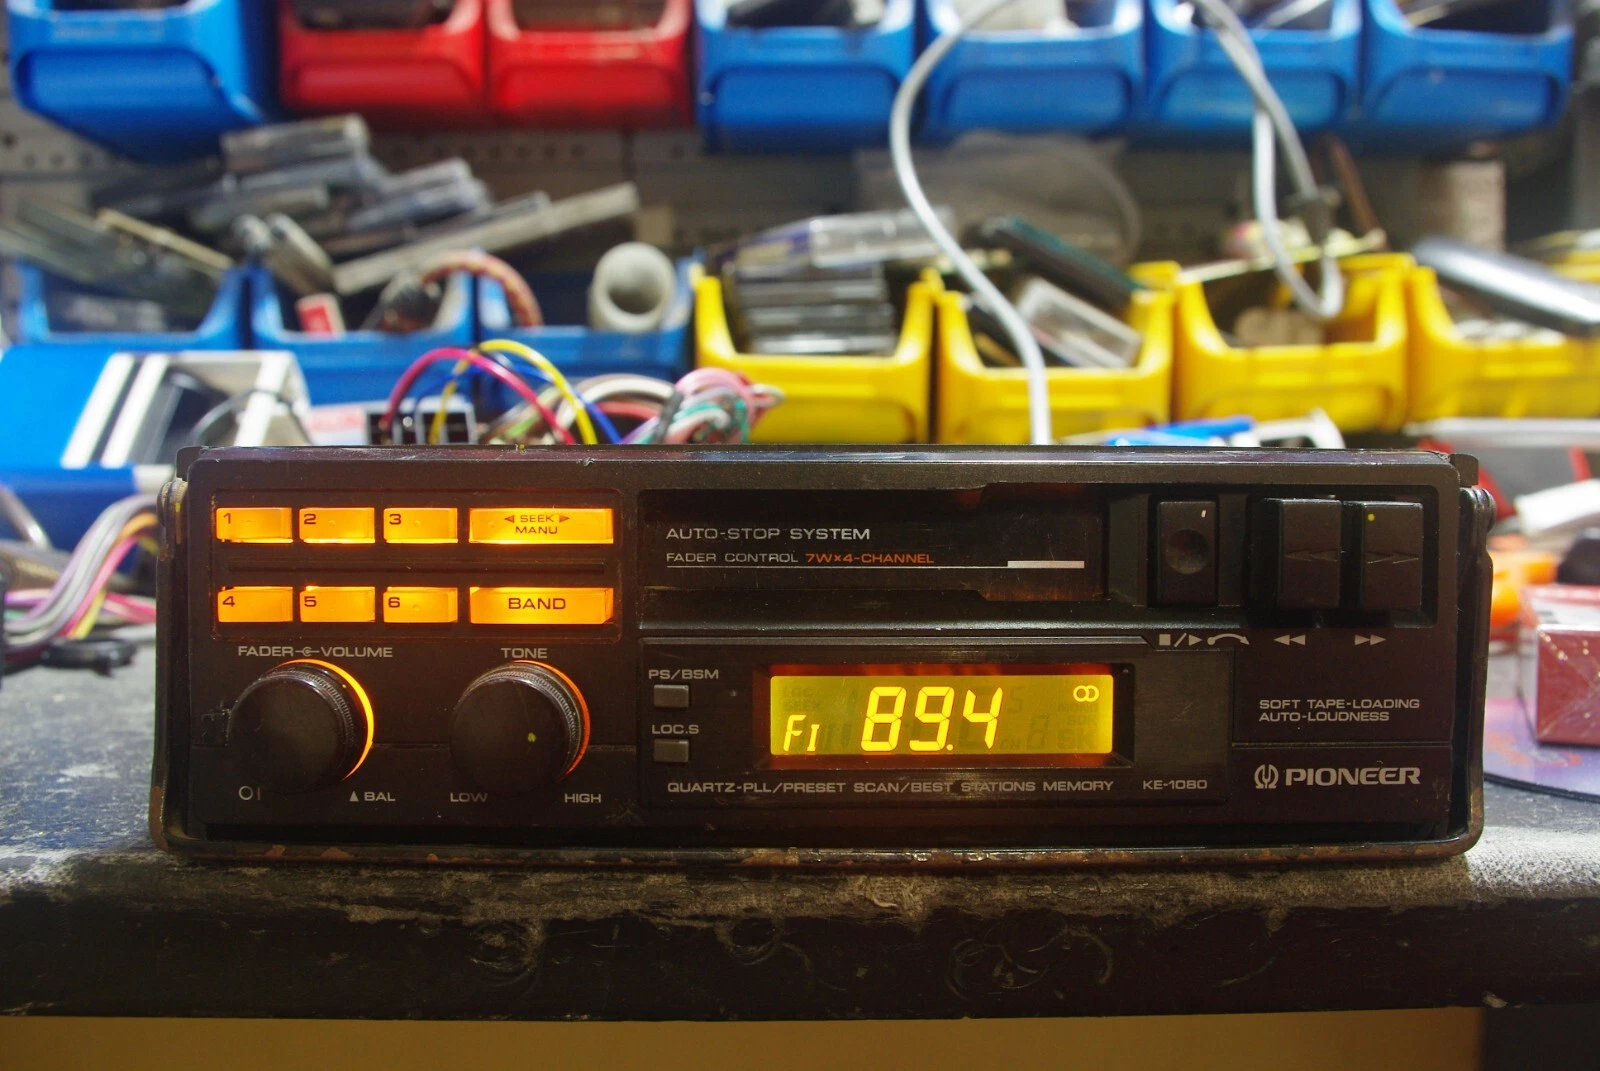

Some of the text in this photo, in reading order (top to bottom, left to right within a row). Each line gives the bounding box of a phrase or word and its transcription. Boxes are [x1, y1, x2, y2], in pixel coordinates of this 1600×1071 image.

[223, 512, 232, 524] 1
[303, 513, 317, 525] 2
[389, 513, 402, 525] 3
[520, 514, 554, 523] SEEK
[515, 525, 558, 535] MANU
[665, 527, 870, 540] AUTO-STOP SYSTEM
[666, 552, 717, 563] FADER
[724, 553, 798, 563] CONTROL
[222, 595, 236, 607] 4
[303, 595, 317, 608] 5
[387, 596, 401, 609] 6
[508, 597, 566, 610] BAND
[238, 645, 393, 658] FADER VOLUME
[500, 647, 549, 658] TONE
[648, 668, 719, 680] PS/BSM
[1259, 698, 1420, 710] SOFT TAPE-LOADING
[860, 686, 1004, 752] 89.4
[1258, 711, 1390, 722] AUTO-LOUDNESS
[651, 724, 700, 735] LOC.S
[1285, 767, 1421, 786] PIONEER
[667, 780, 1115, 794] QUARTZ-PLL/PRESET SCAN/BEST STATIONS MEMORY
[1142, 779, 1208, 790] KE-1080
[364, 791, 396, 802] BAL
[449, 792, 487, 803] LOW
[564, 793, 602, 803] HIGH
